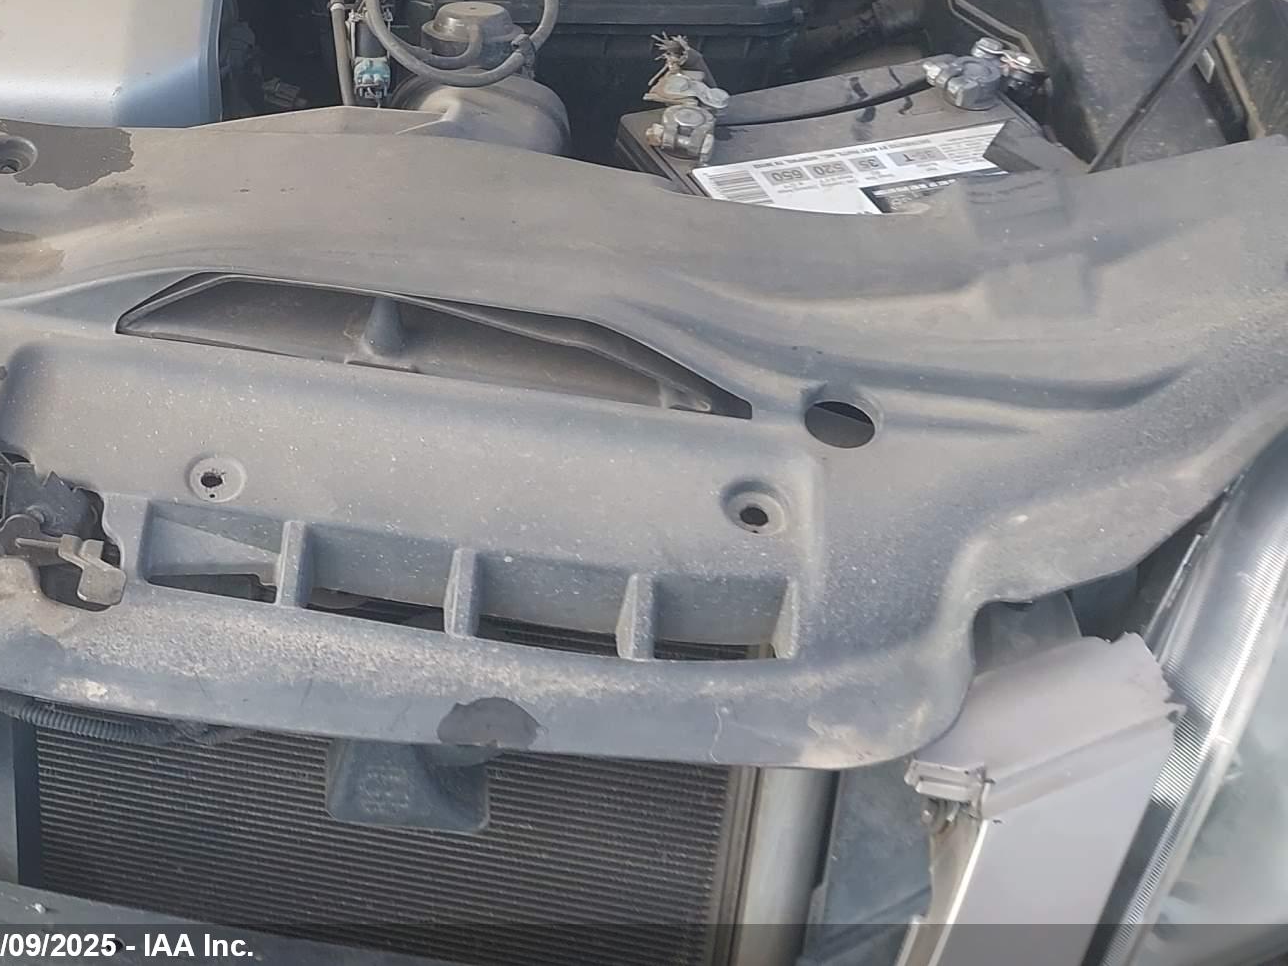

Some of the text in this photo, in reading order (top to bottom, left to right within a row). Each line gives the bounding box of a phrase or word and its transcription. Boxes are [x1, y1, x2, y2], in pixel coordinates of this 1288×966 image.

[812, 162, 844, 175] 520
[858, 158, 880, 170] 35
[772, 168, 803, 182] 650
